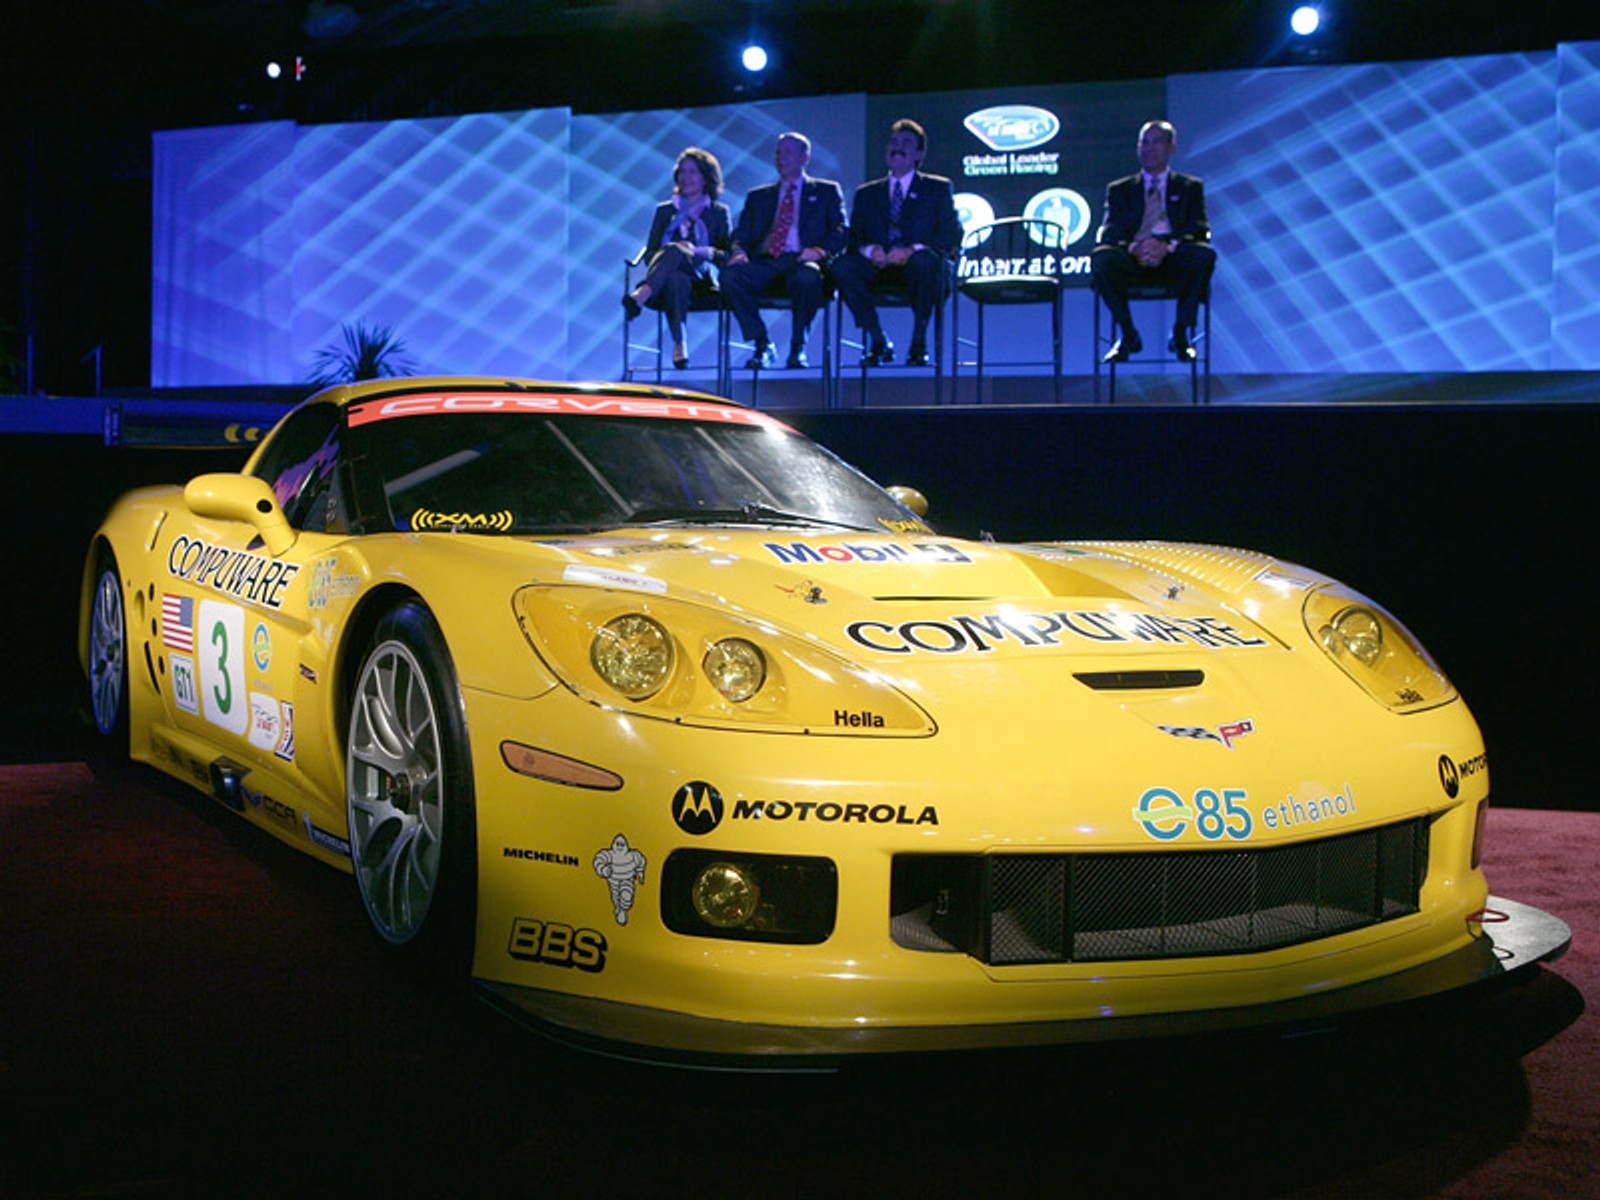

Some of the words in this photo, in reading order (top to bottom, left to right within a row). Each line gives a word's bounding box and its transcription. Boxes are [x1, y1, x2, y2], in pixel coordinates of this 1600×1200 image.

[380, 396, 768, 423] CORVETT
[168, 535, 299, 608] COMPUWARE
[764, 543, 909, 563] Mobil
[847, 611, 1266, 655] COMPUWARE
[174, 663, 195, 703] GT1
[211, 620, 232, 715] 3
[833, 709, 885, 729] Hella
[732, 799, 940, 826] MOTOROLA
[1263, 783, 1356, 828] ethanol
[503, 847, 580, 867] MICHELIN
[508, 917, 608, 973] BBS
